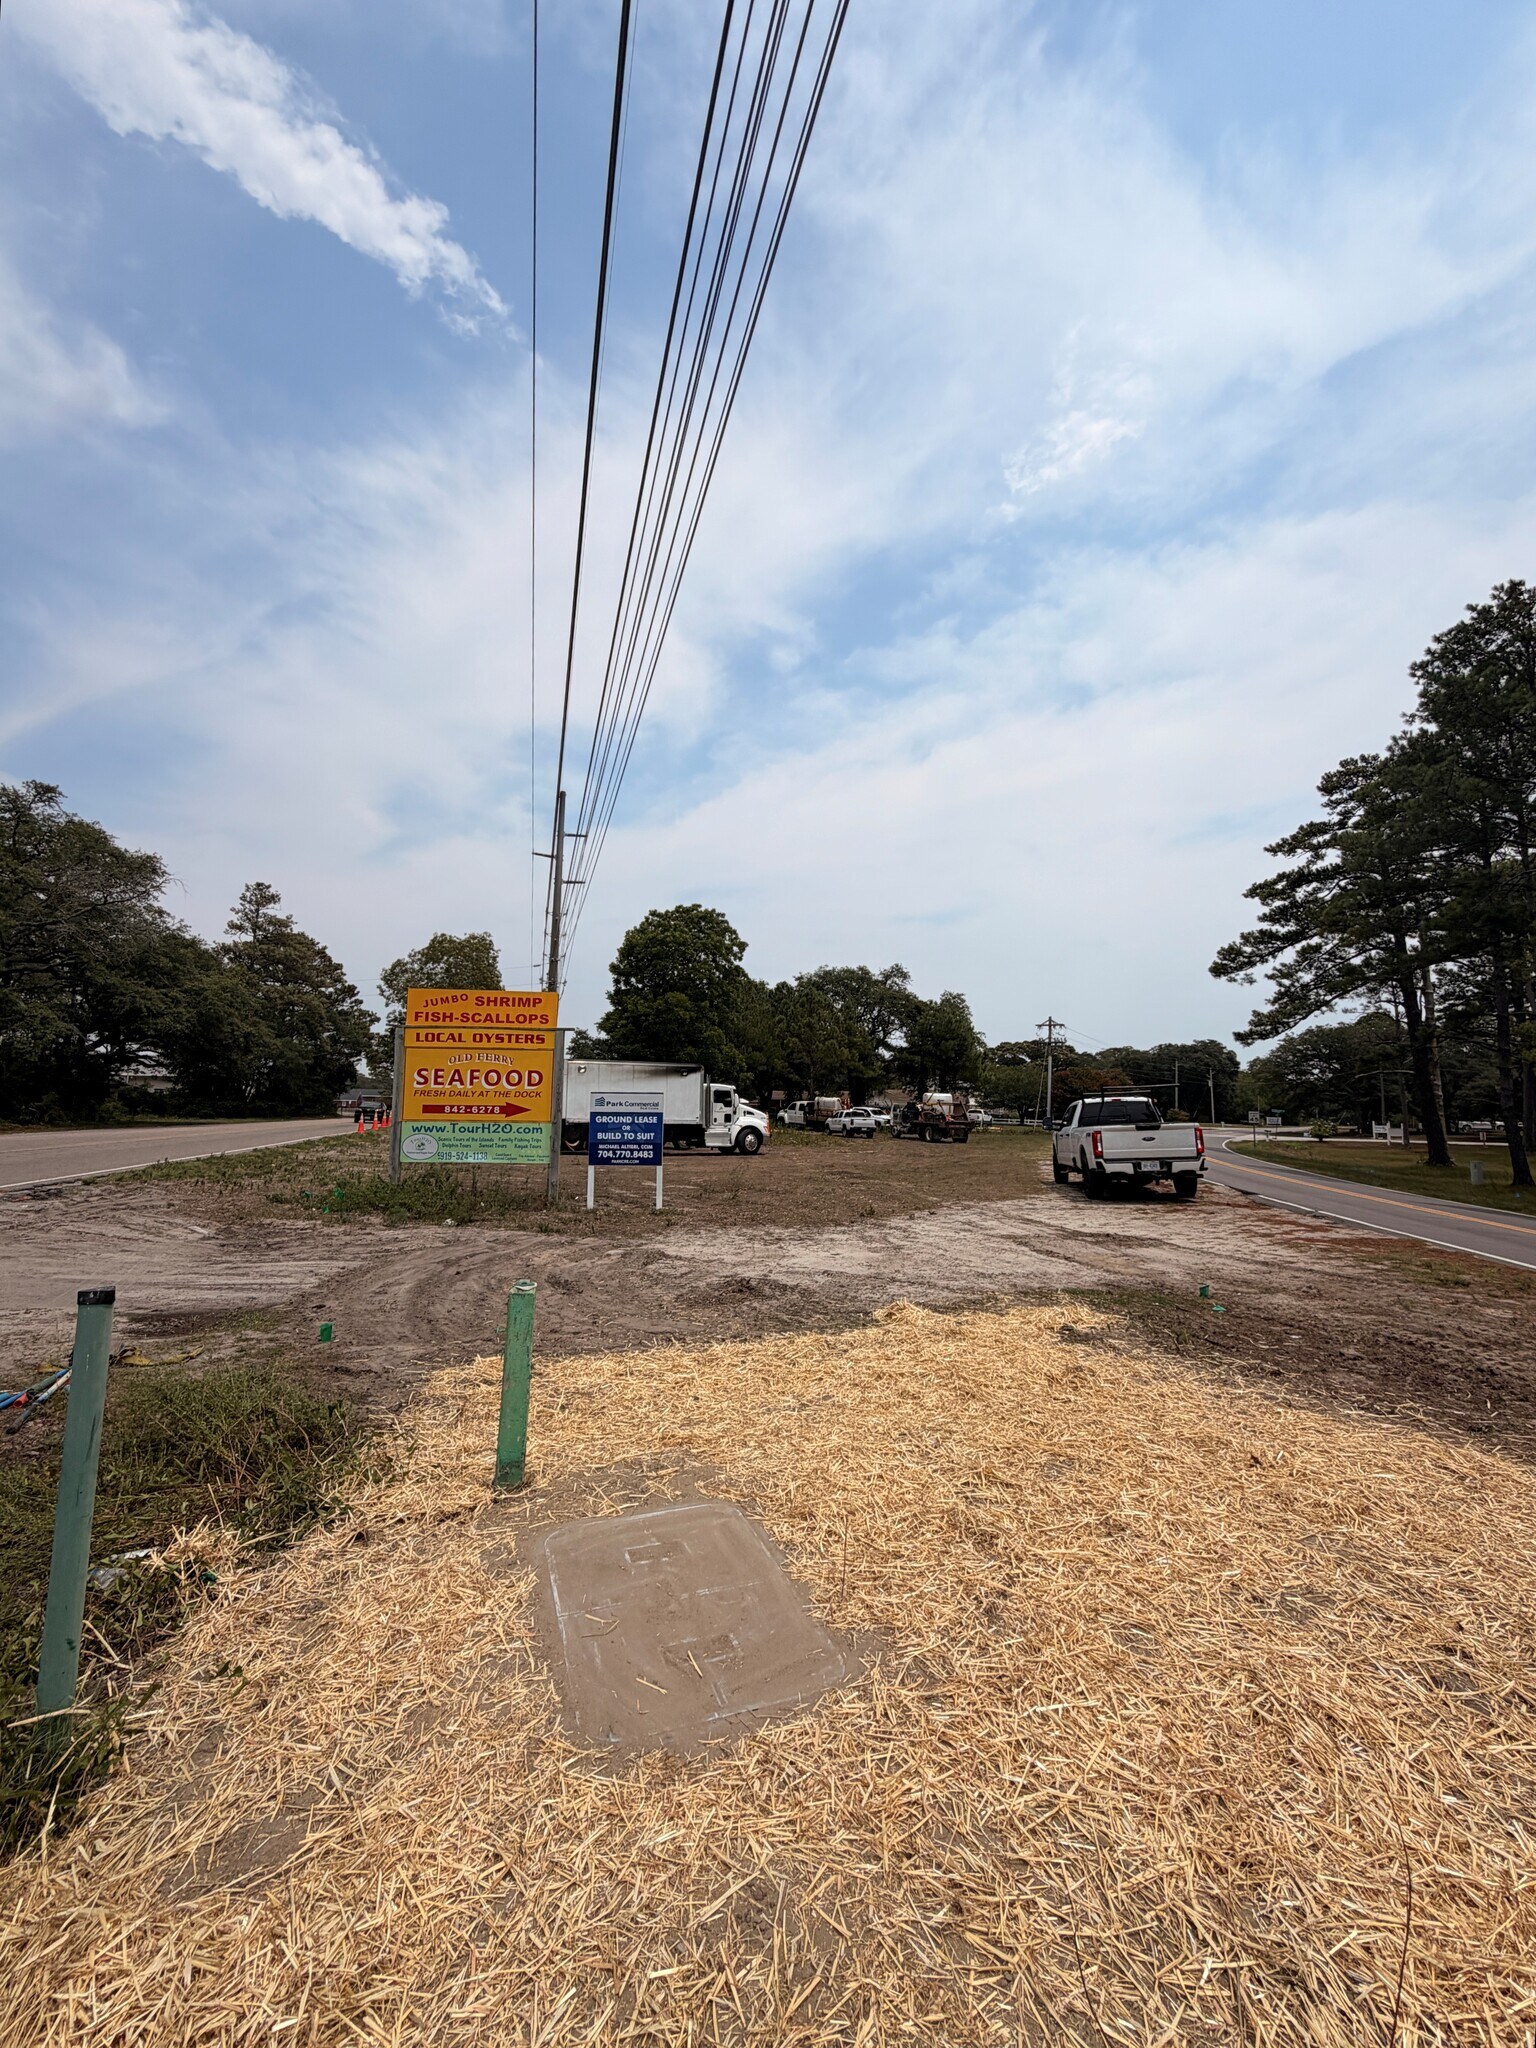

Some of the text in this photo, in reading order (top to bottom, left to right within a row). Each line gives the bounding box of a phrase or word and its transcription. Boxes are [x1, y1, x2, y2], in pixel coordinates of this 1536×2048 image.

[423, 993, 543, 1008] JUMBO SHRIMP
[414, 1011, 549, 1025] FISH-SCALLOPS
[415, 1032, 545, 1045] LOCAL OYSTERS
[448, 1053, 515, 1067] OLD FERRY
[413, 1068, 544, 1090] SEAFOOD
[413, 1089, 543, 1099] FRESH DAILY AT THE DOCK
[444, 1105, 500, 1114] 842-6278
[595, 1115, 658, 1124] GROUND LEASE
[411, 1122, 543, 1135] www.TourH2O.com
[597, 1132, 655, 1140] BUILD TO SUIT
[597, 1150, 654, 1158] 704.770.8483
